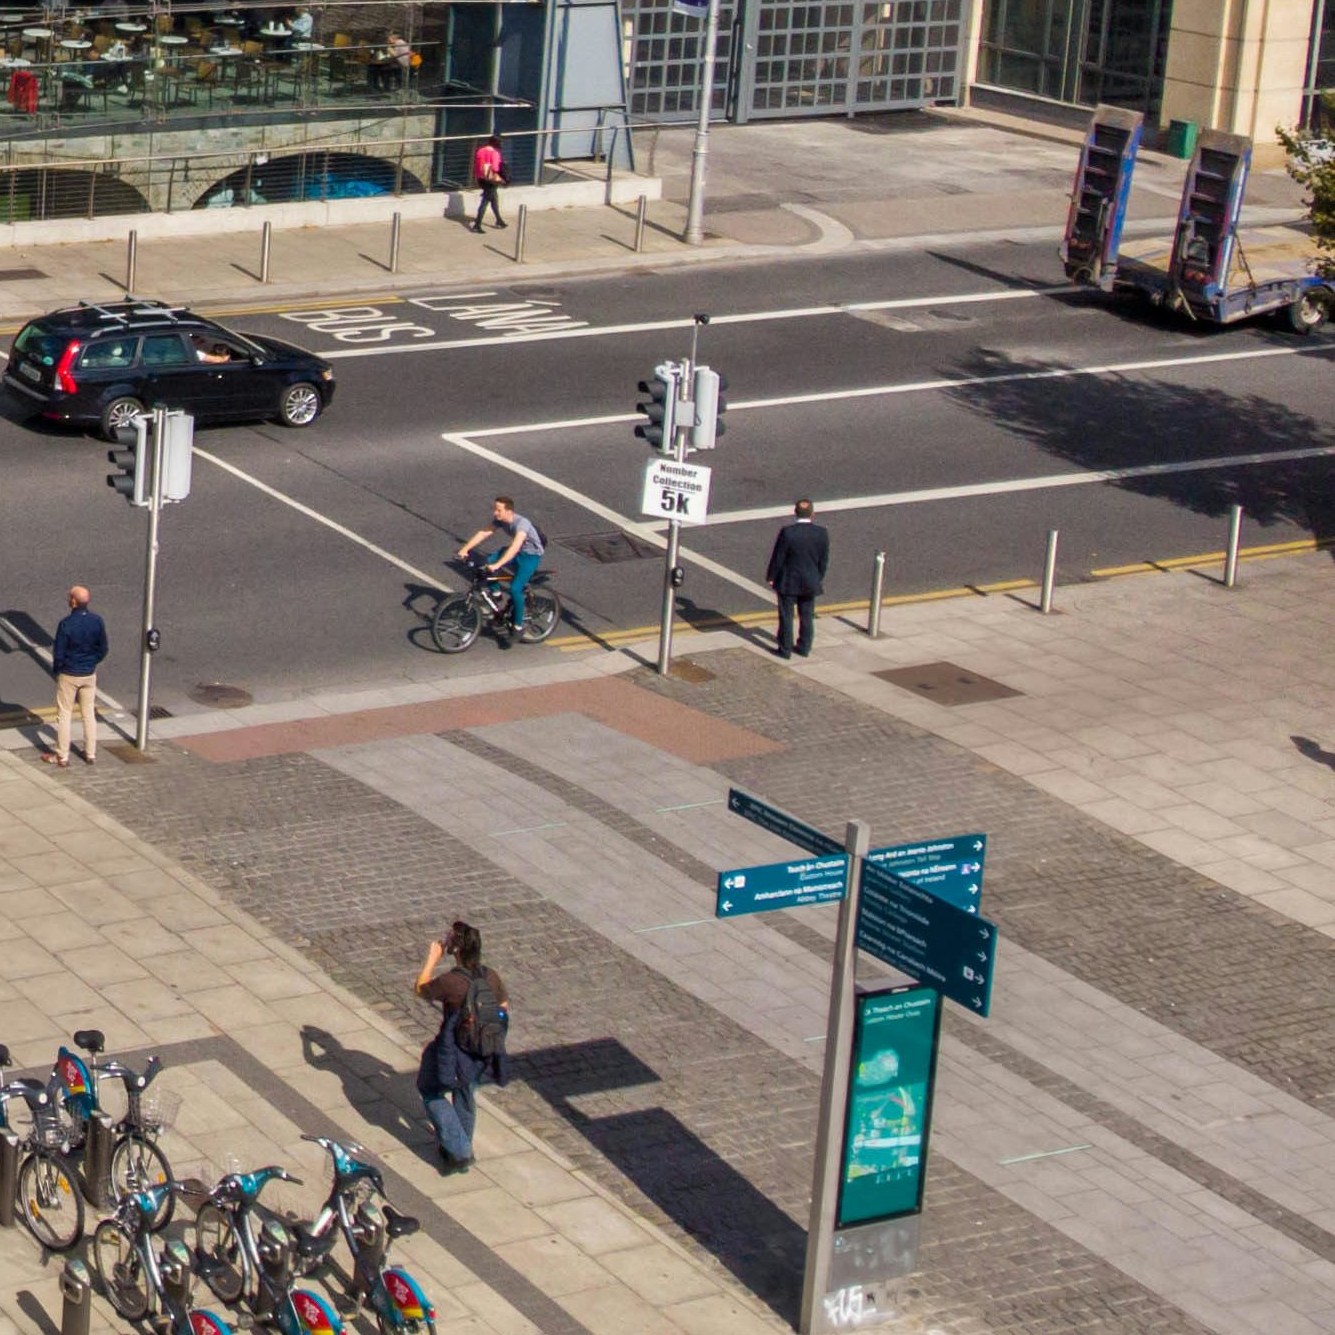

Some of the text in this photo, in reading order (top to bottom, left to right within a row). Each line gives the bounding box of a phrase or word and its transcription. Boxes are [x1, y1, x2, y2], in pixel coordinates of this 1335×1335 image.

[279, 305, 436, 344] BUS
[660, 463, 699, 479] Number
[653, 474, 704, 493] Collection
